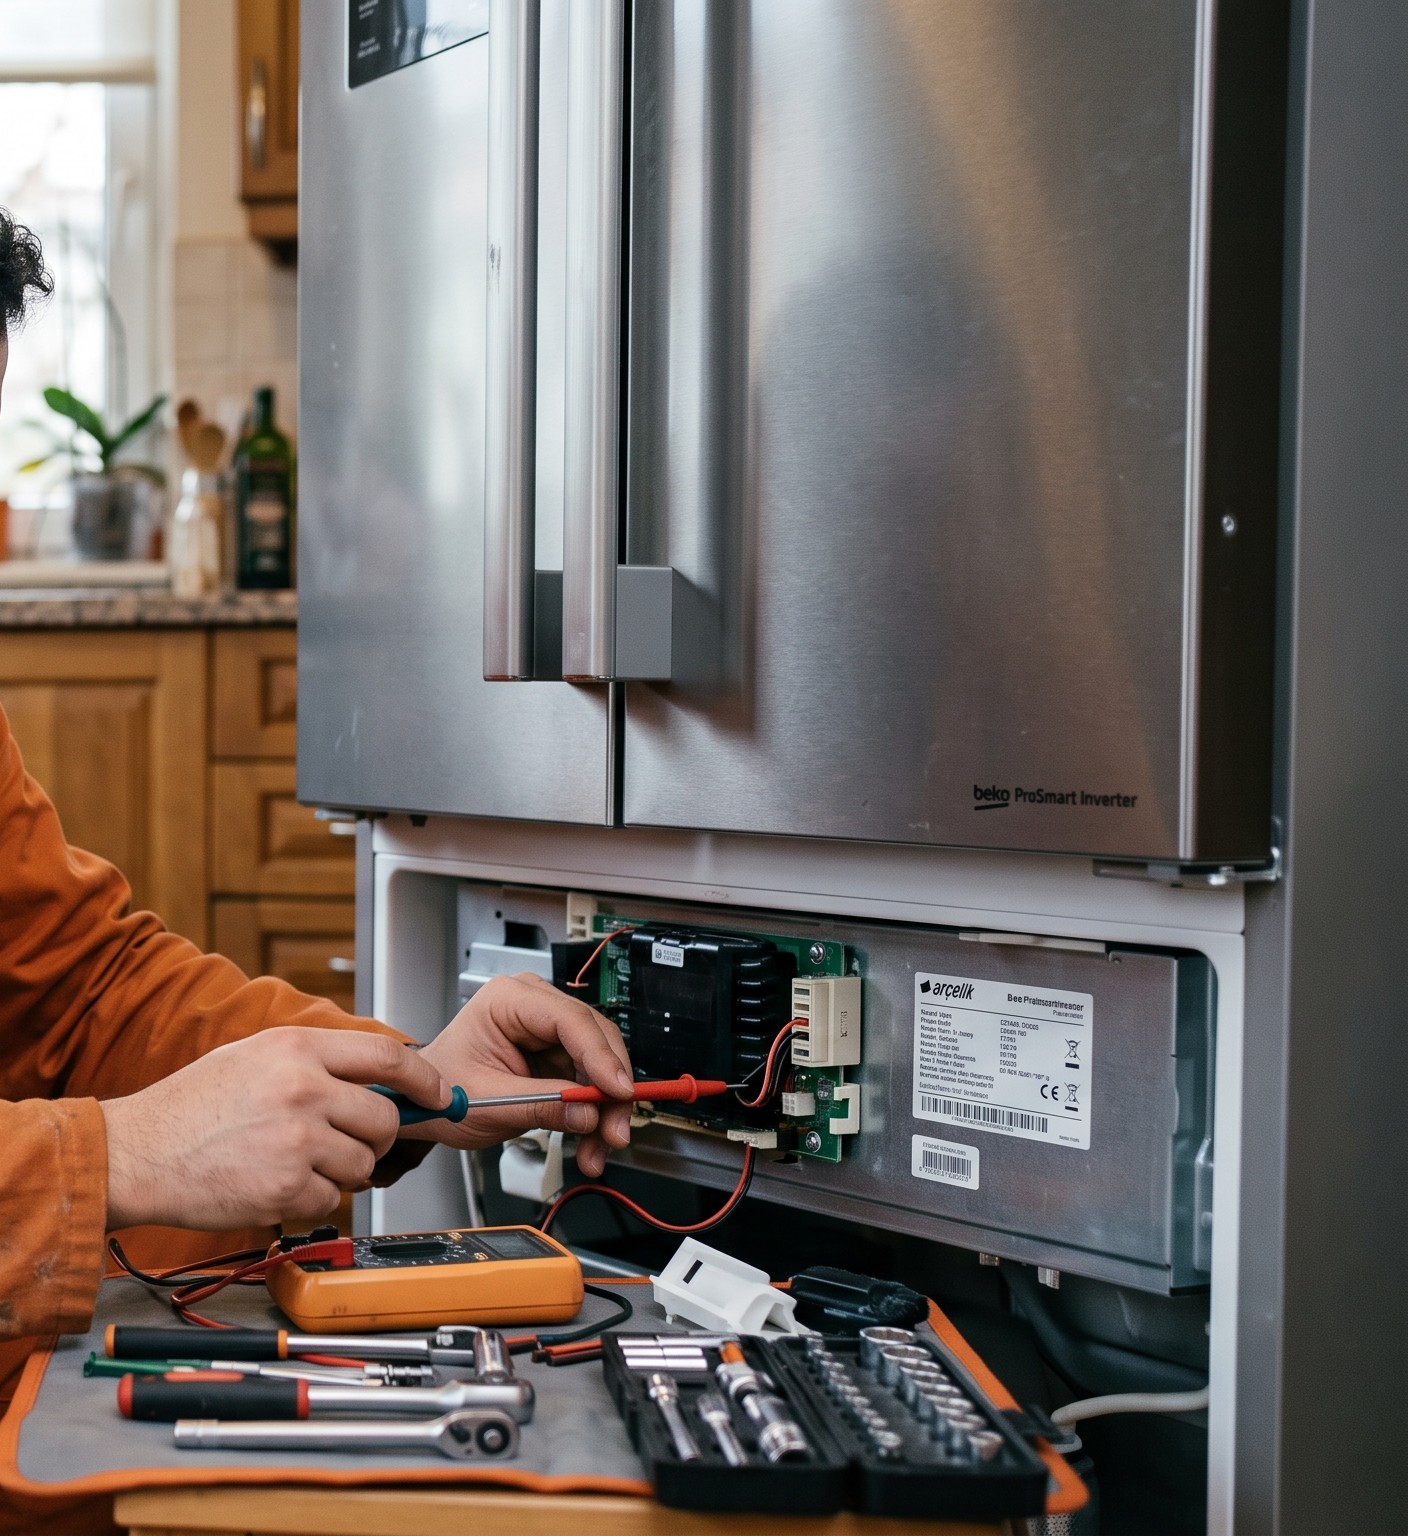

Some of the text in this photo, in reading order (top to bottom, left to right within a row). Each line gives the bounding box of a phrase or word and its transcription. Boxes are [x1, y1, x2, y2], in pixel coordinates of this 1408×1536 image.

[973, 785, 1138, 808] beko ProSmart Inverter
